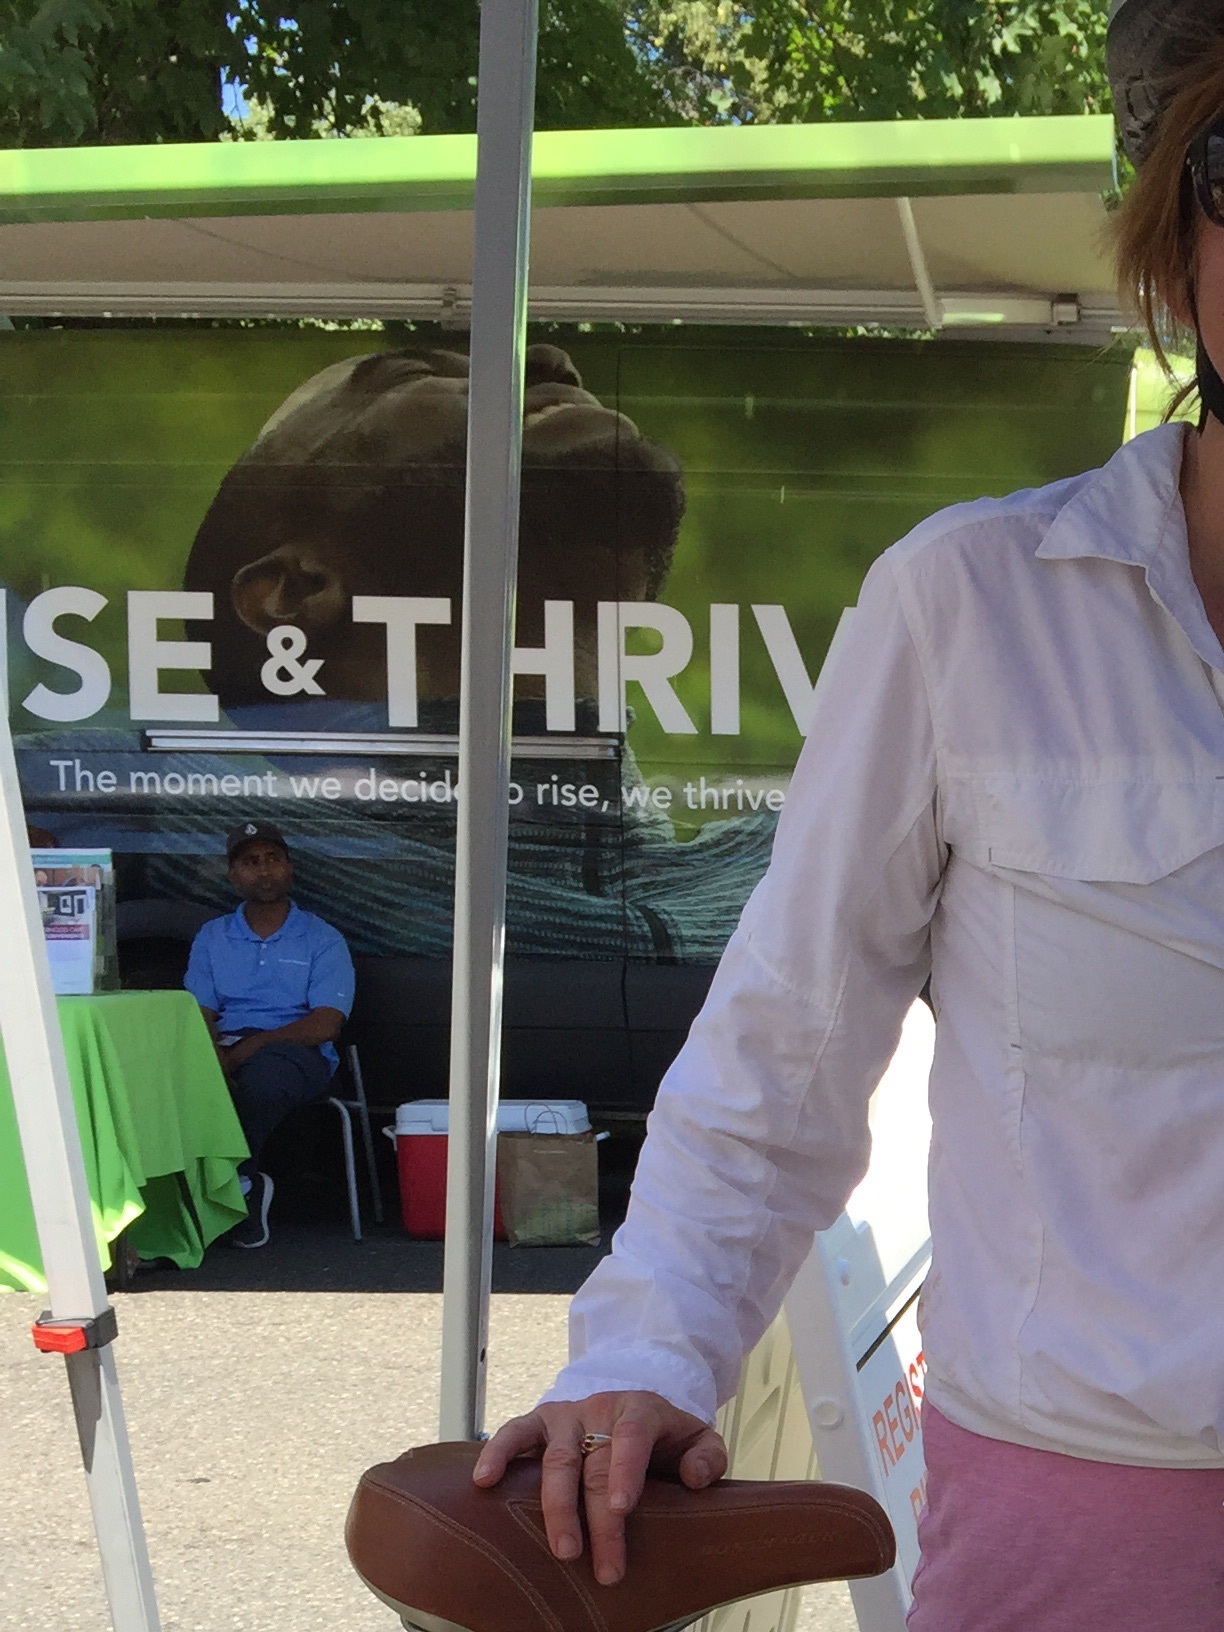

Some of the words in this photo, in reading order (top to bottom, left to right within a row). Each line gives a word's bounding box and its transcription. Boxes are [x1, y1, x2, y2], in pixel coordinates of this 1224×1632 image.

[0, 586, 219, 722] SE
[260, 625, 326, 696] &
[49, 759, 118, 794] The
[130, 767, 278, 799] moment
[290, 774, 342, 801] we
[537, 774, 608, 813] rise,
[621, 782, 673, 810] we
[683, 776, 786, 812] thrive
